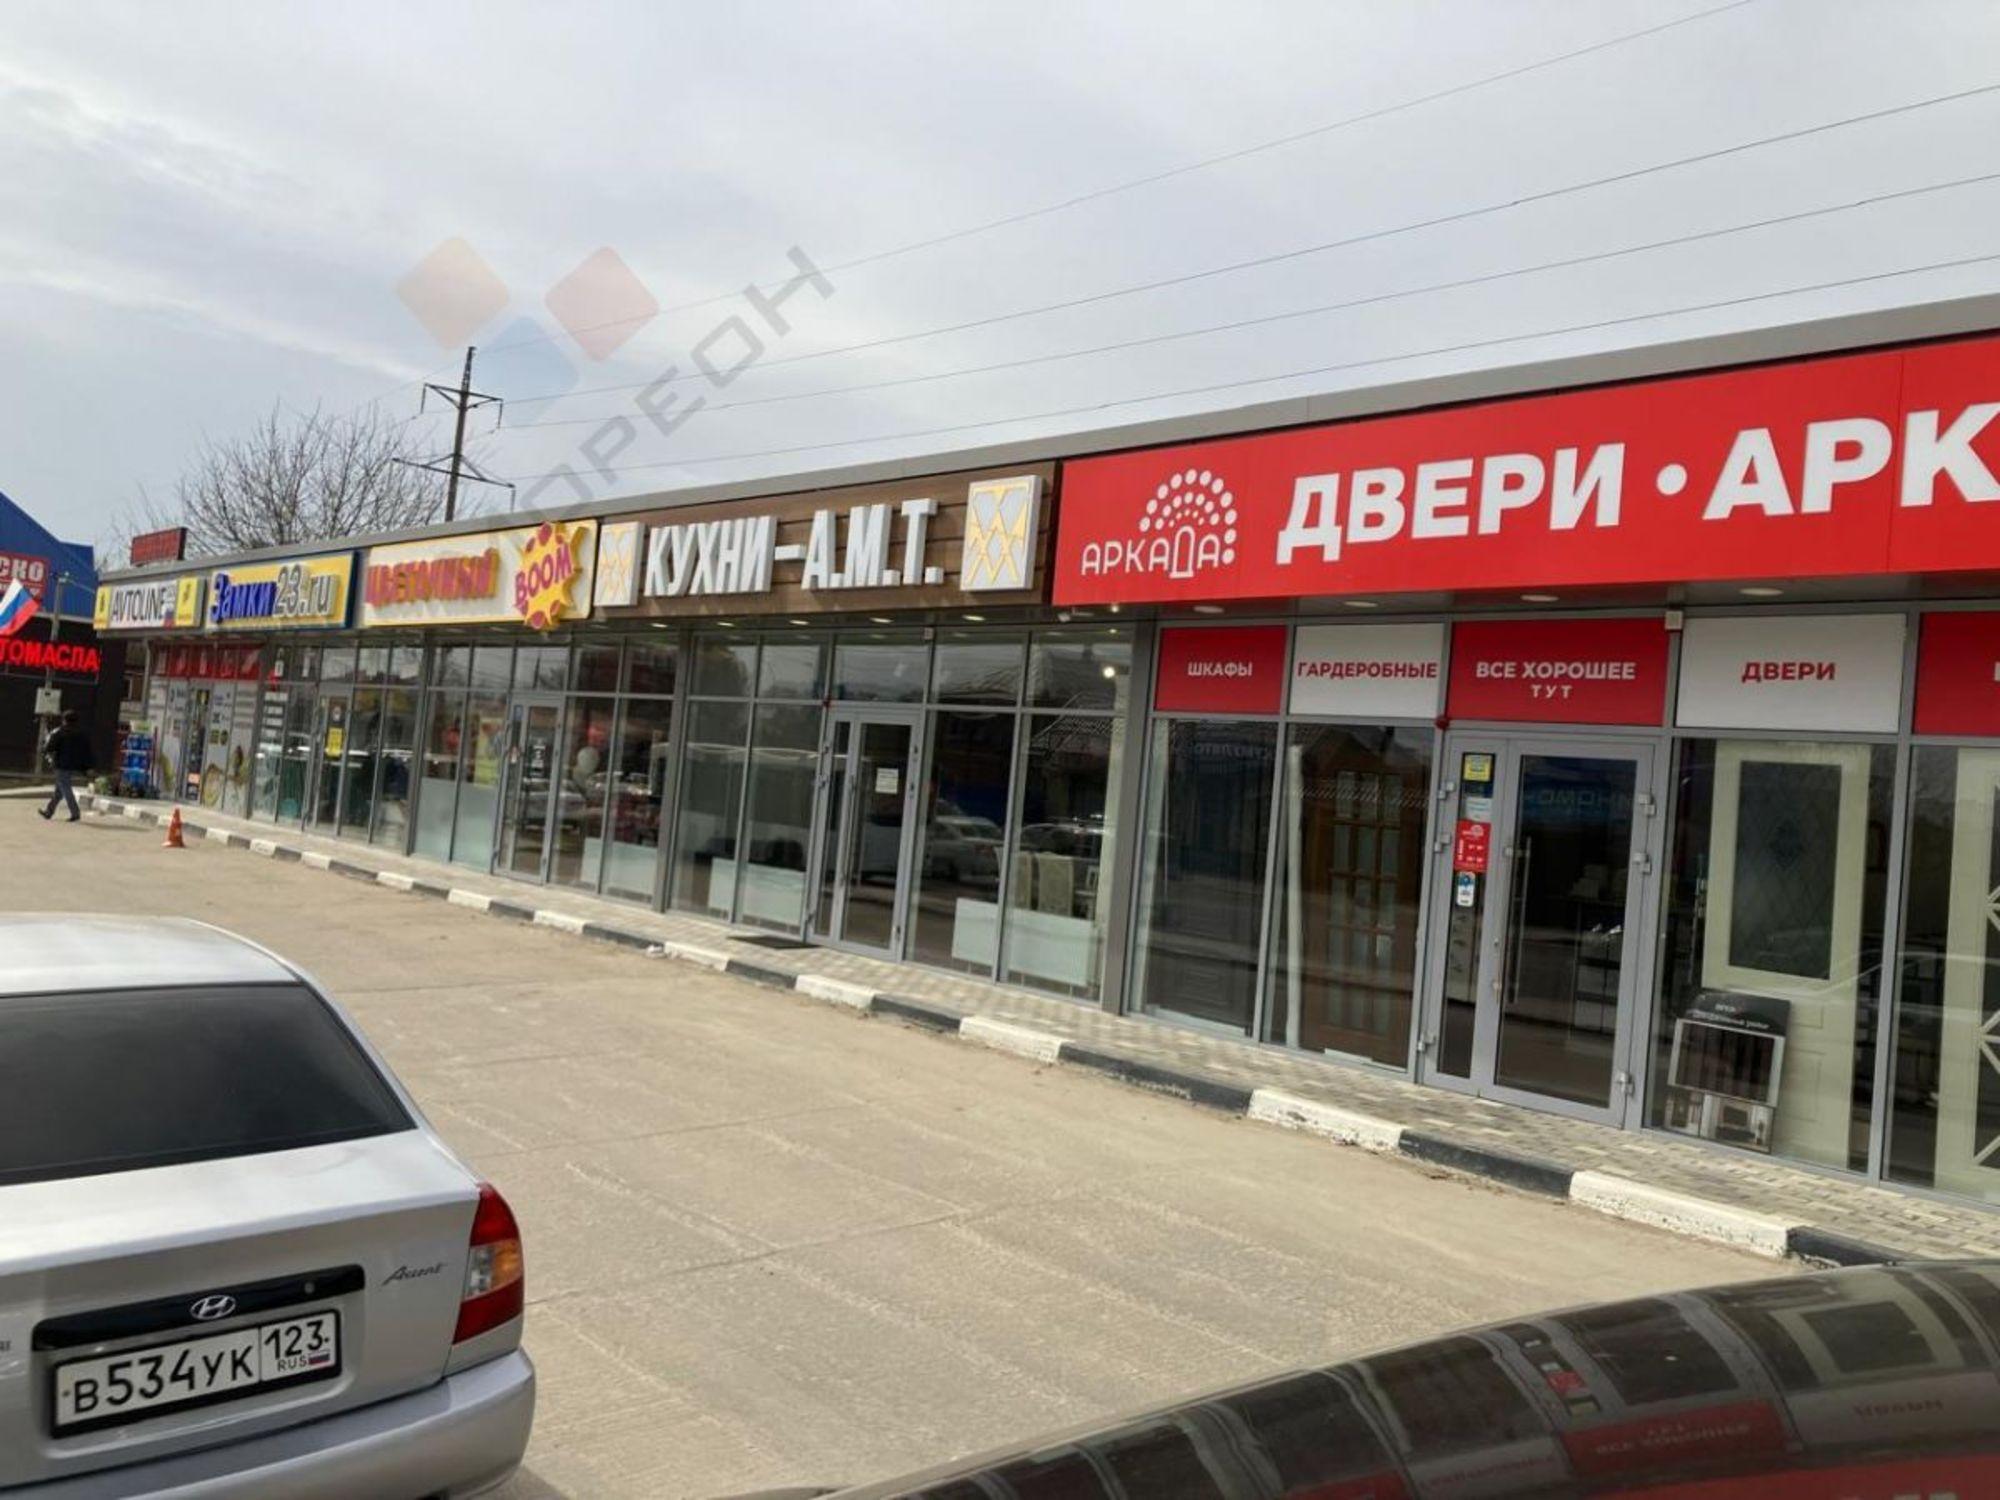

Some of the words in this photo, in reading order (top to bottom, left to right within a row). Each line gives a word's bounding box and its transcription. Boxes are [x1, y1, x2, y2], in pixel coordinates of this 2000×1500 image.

[1276, 442, 1625, 565] ДВЕРИ
[1081, 525, 1220, 579] АРКАДА
[515, 542, 573, 602] BOOM
[1187, 661, 1253, 678] ШКАФЫ
[1297, 661, 1438, 680] ГАРДЕРОБНЫЕ
[1476, 661, 1516, 678] ВСЕ
[1522, 661, 1636, 680] ХОРОШЕЕ
[1741, 661, 1837, 684] ДВЕРИ
[1531, 684, 1573, 699] ТУТ
[380, 1261, 448, 1287] Accent
[264, 1319, 324, 1360] 123
[277, 1355, 310, 1372] RUS
